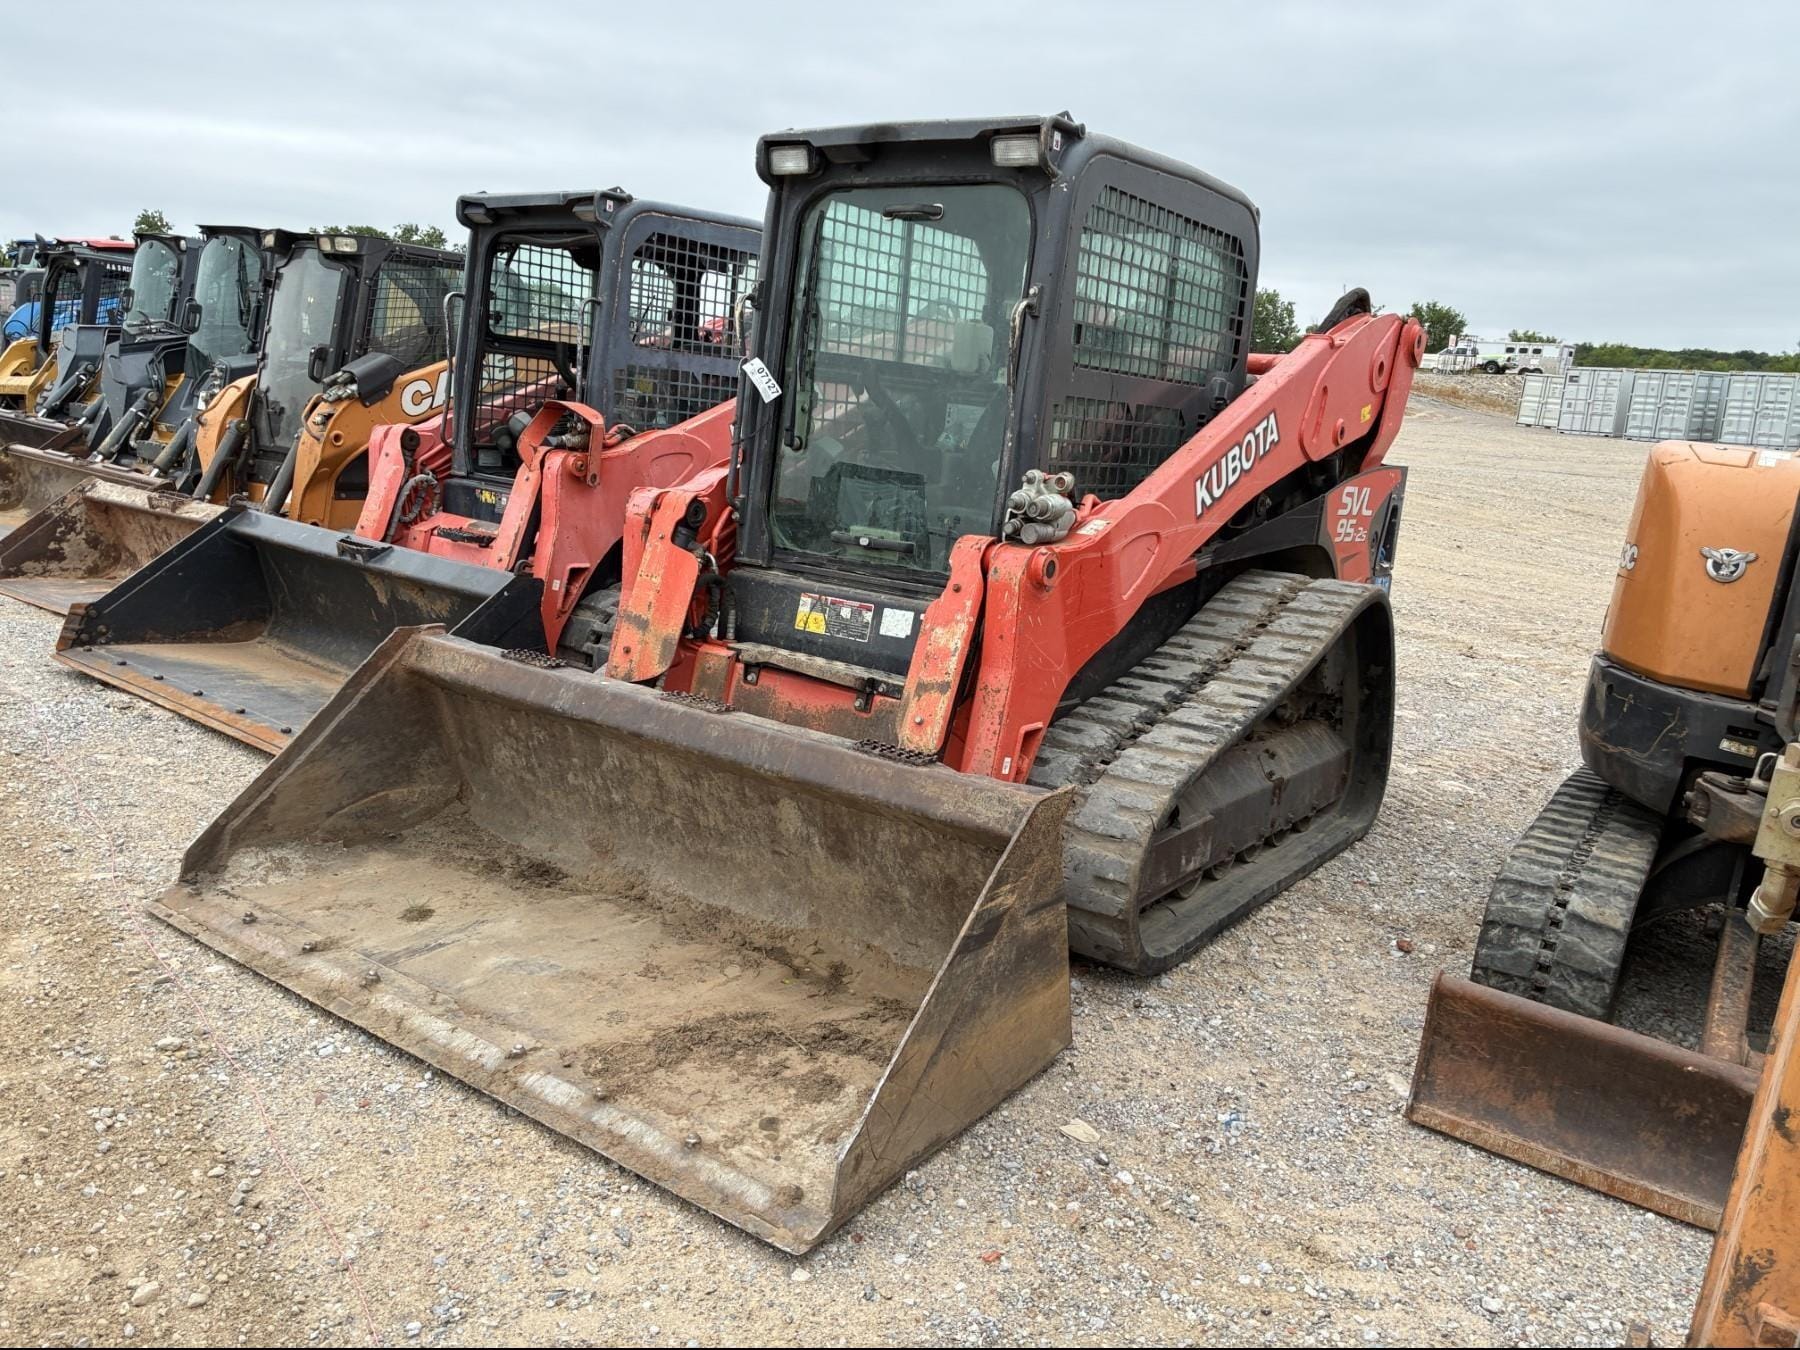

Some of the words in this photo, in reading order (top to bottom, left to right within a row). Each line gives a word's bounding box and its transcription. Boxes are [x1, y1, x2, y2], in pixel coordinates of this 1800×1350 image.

[757, 367, 779, 394] 07127
[1195, 411, 1279, 517] KUBOTA
[1337, 486, 1372, 516] SVL
